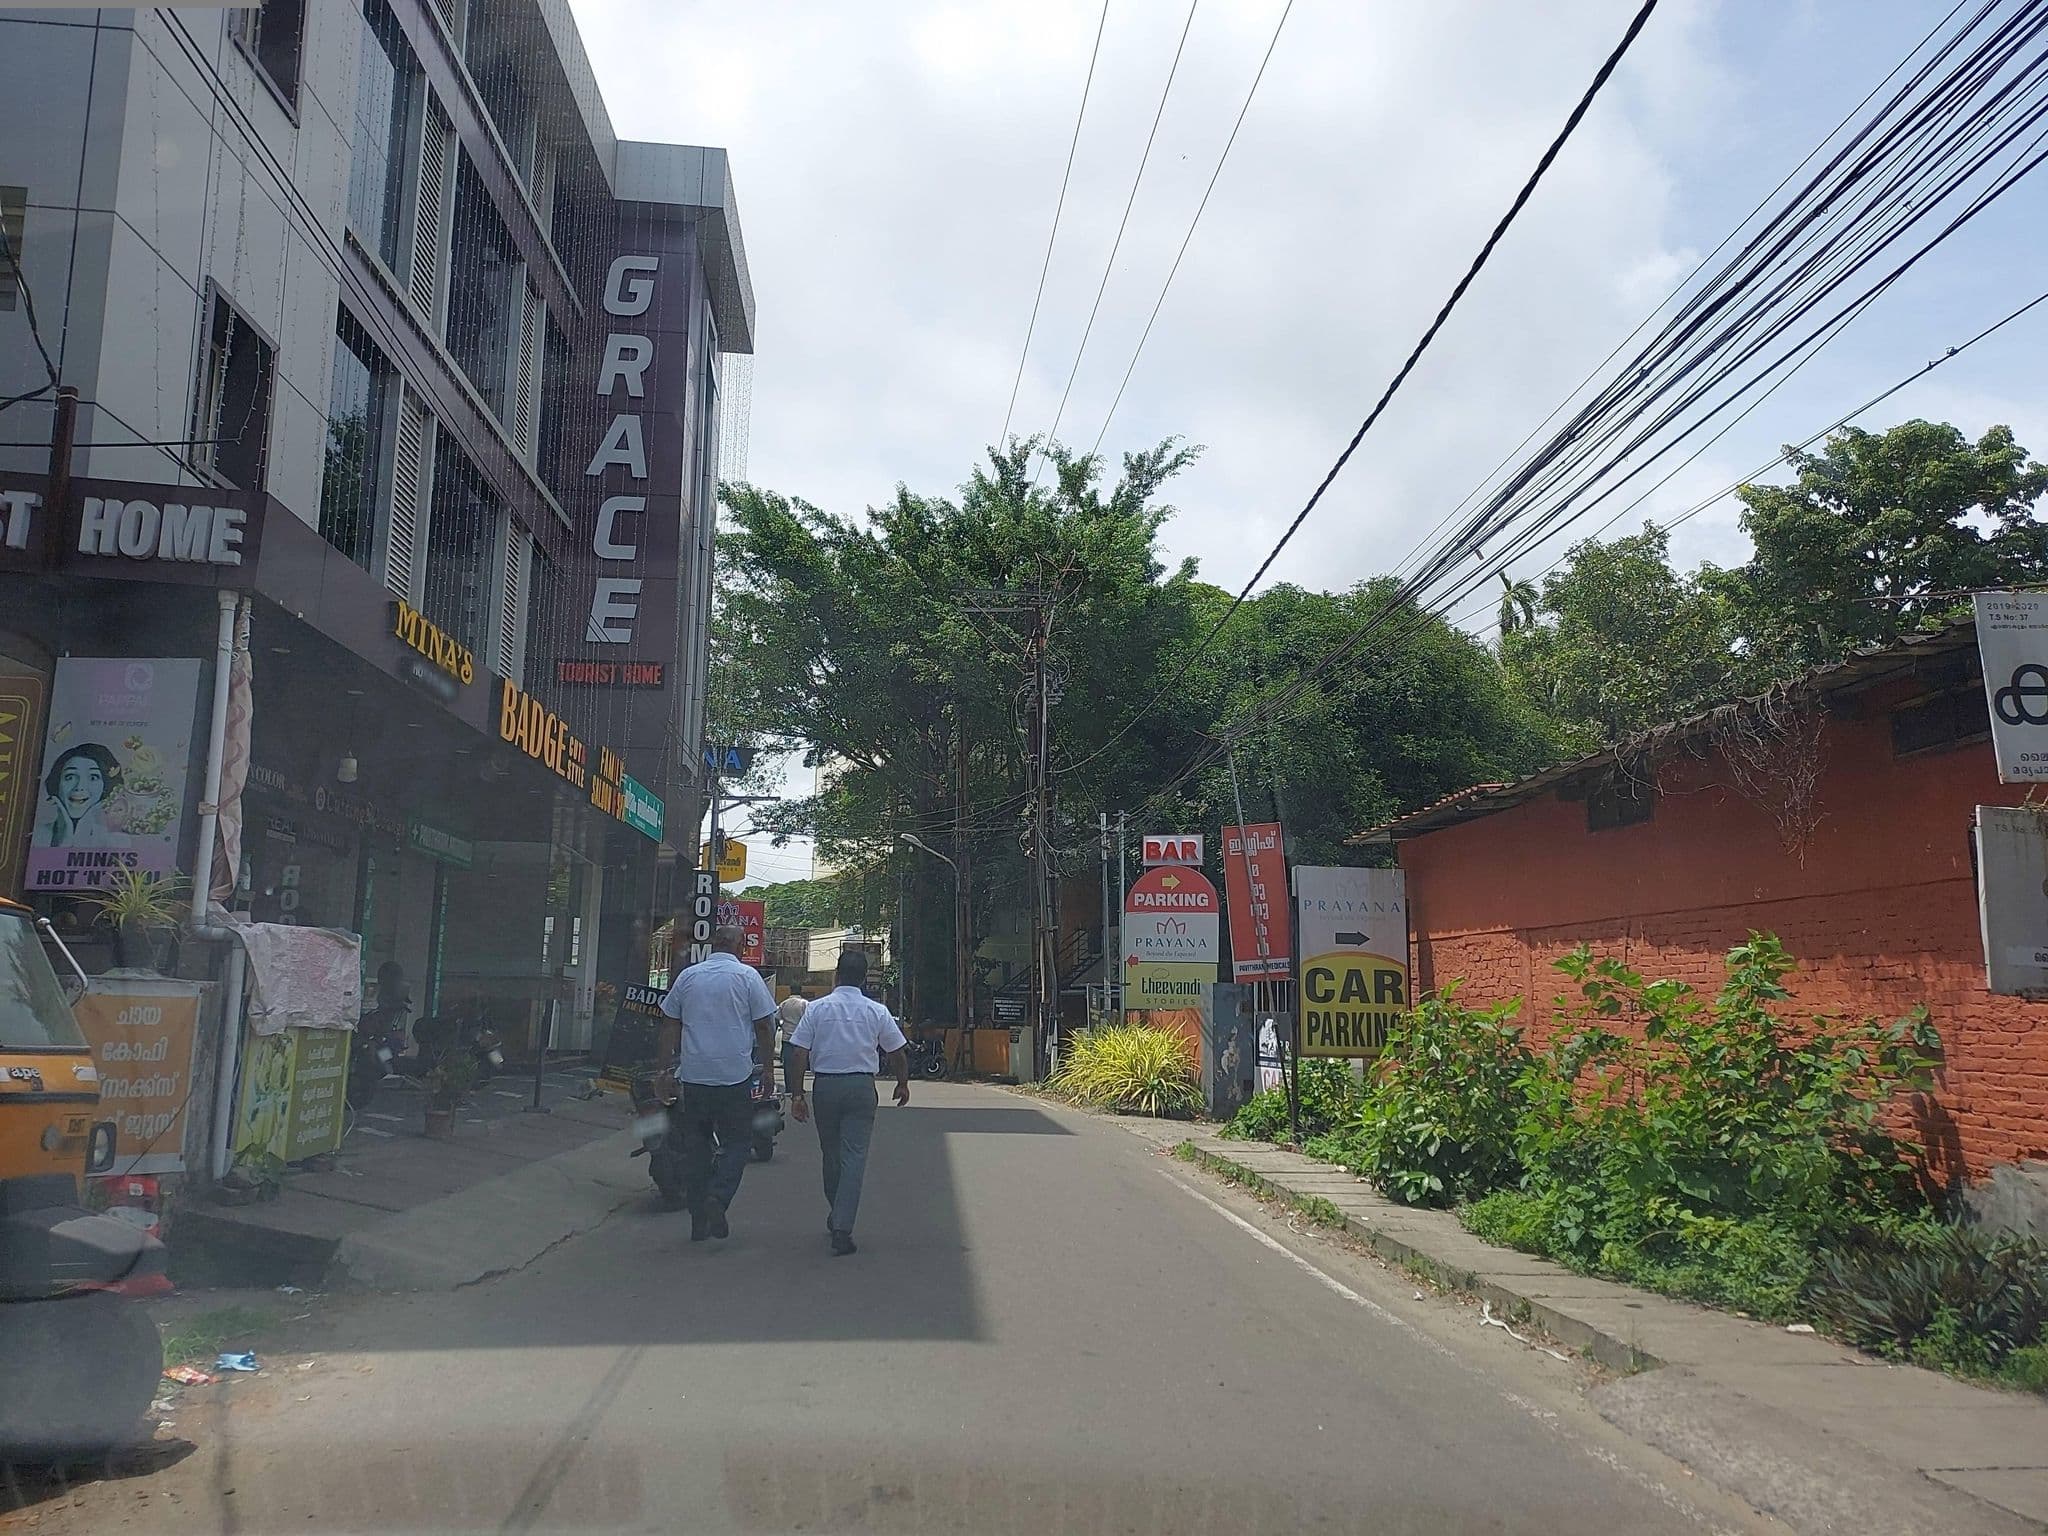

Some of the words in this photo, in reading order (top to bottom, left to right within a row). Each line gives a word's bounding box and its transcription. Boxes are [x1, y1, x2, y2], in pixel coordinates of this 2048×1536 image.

[586, 256, 659, 643] GRACE
[78, 497, 247, 566] HOME
[394, 600, 474, 686] MINA'S
[559, 662, 618, 684] TOURIST
[623, 663, 662, 684] HOME
[500, 678, 569, 778] BADGE
[66, 851, 138, 868] MINA'S
[1145, 841, 1199, 861] BAR
[36, 870, 80, 886] HOT
[1134, 893, 1209, 907] PARKING
[1303, 899, 1401, 912] PRAYANA
[1135, 937, 1207, 948] PRAYANA
[1141, 977, 1201, 995] theevandi
[1305, 967, 1405, 1004] CAR
[1146, 998, 1197, 1006] STORIES
[116, 1006, 162, 1025] ചായ
[101, 1036, 169, 1062] കോഫി
